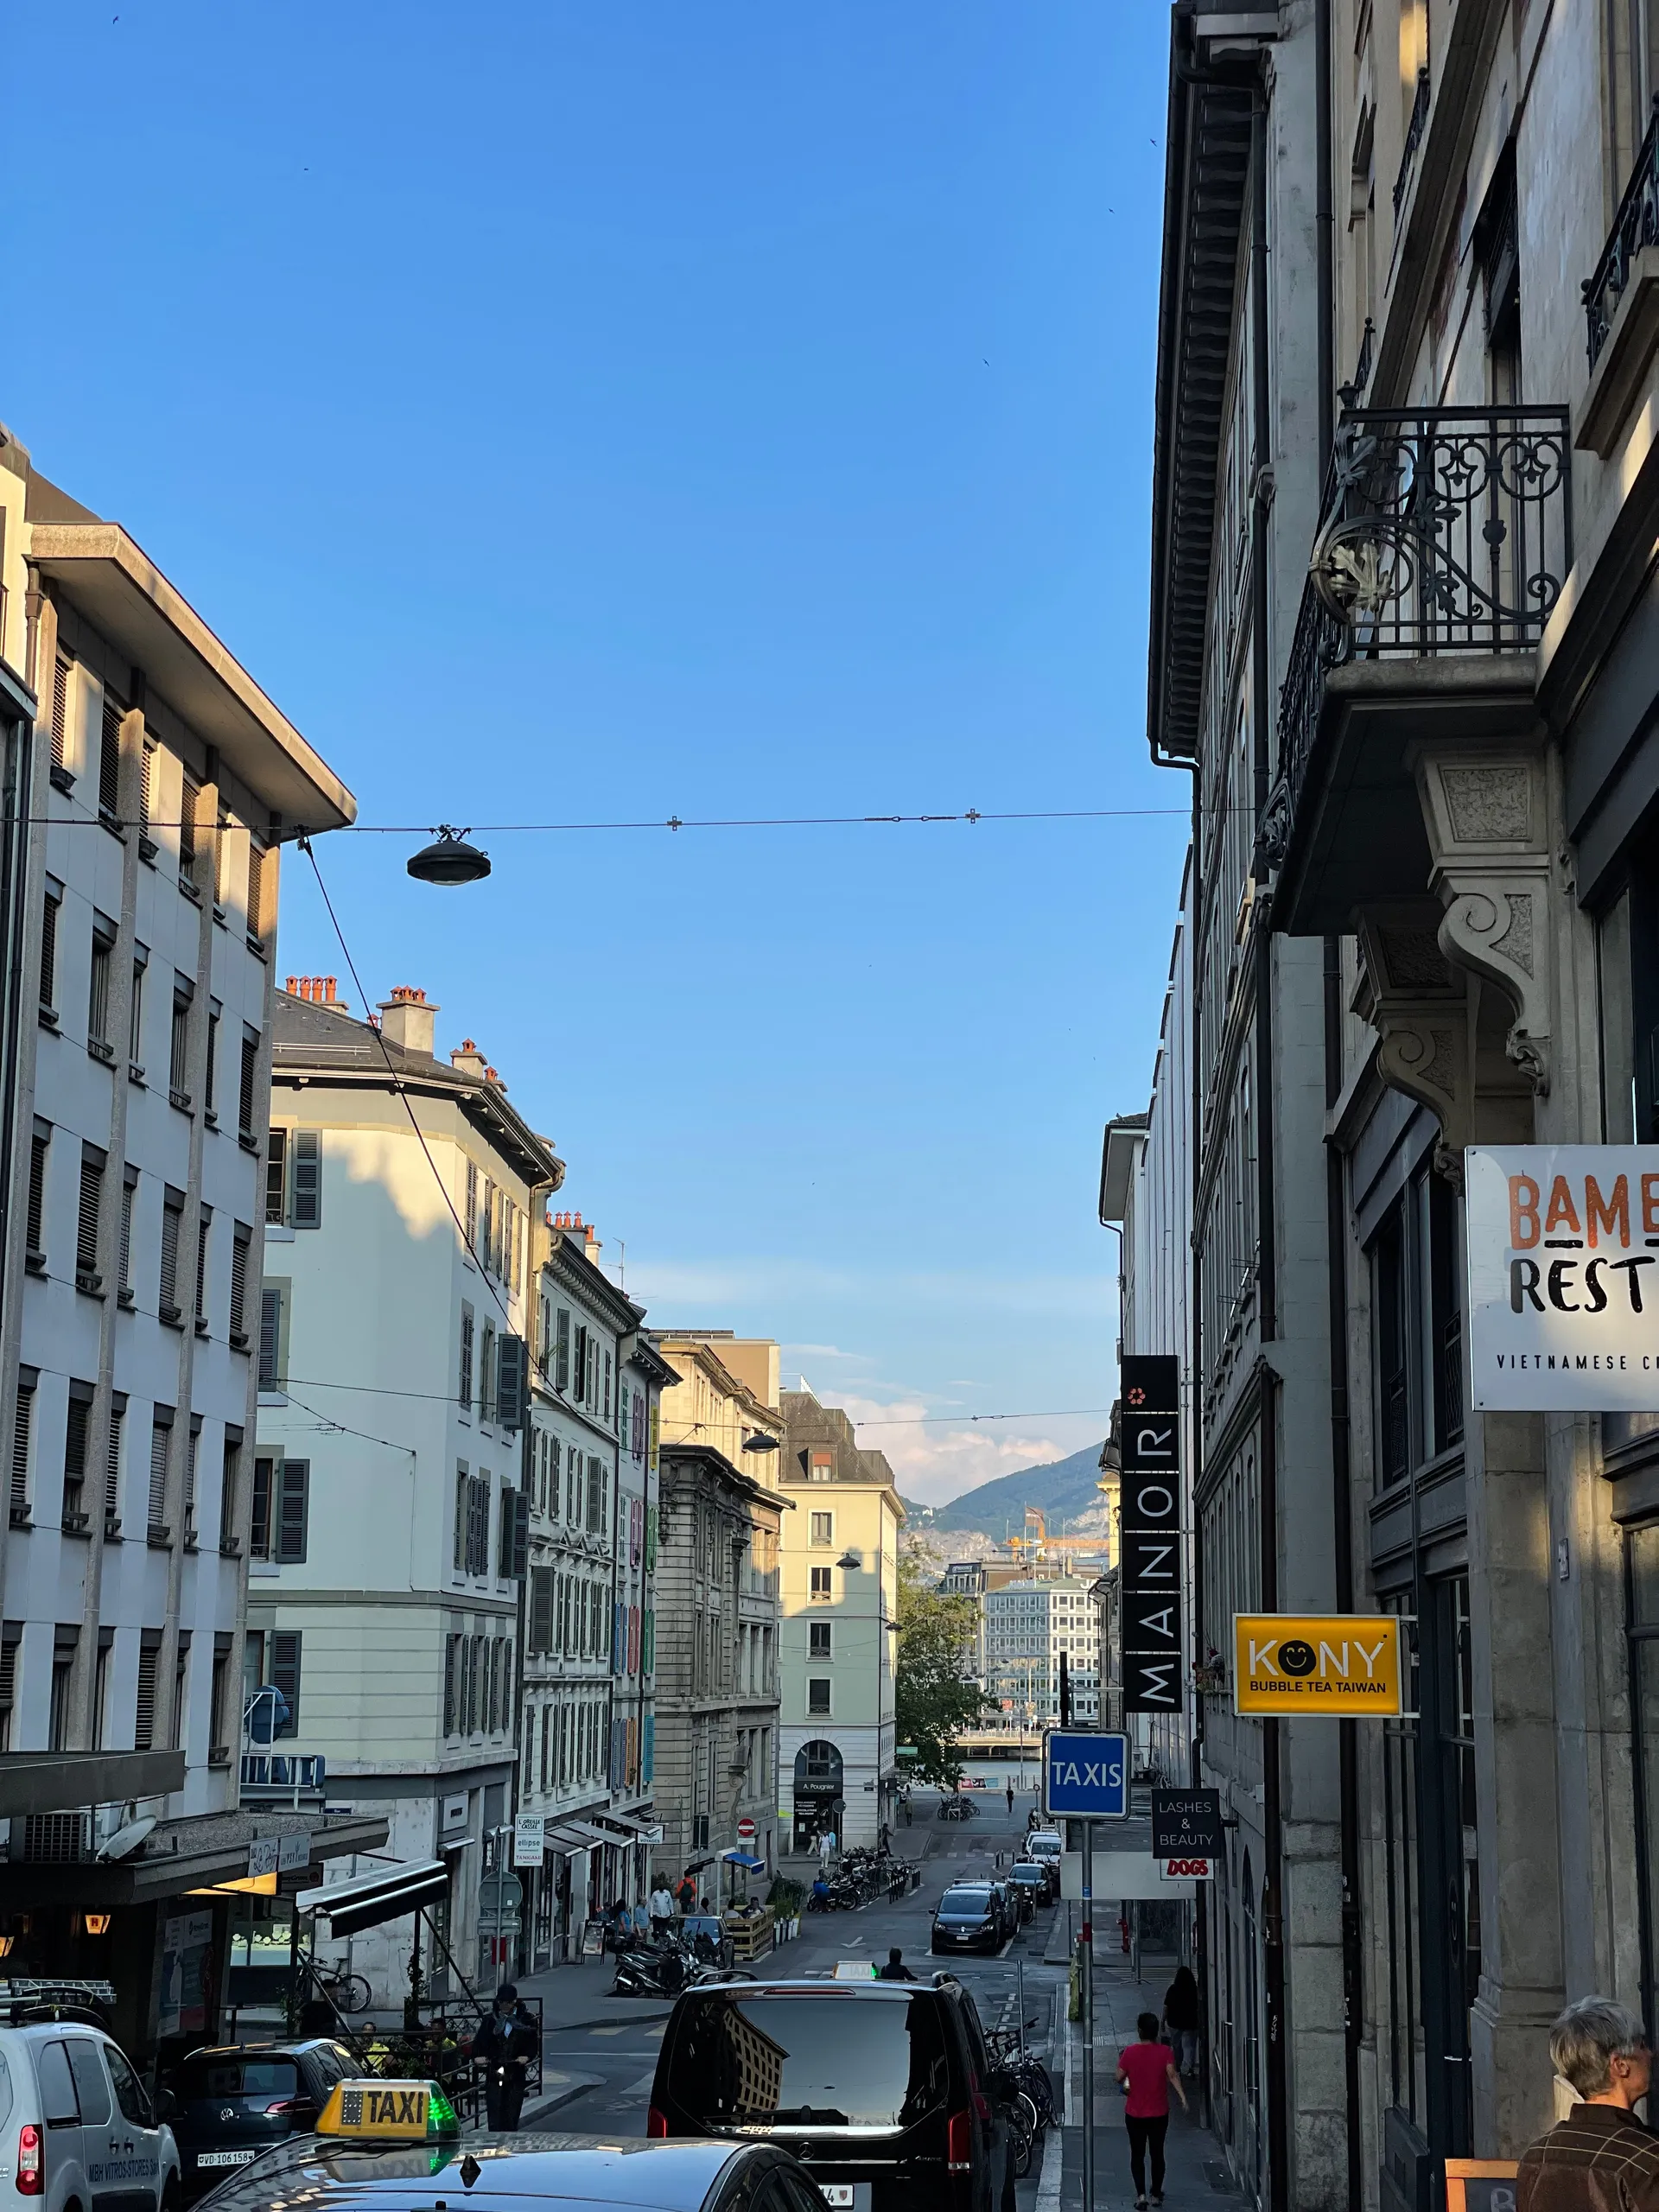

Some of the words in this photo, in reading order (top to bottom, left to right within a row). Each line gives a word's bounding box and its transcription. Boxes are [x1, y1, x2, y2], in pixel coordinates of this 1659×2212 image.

[1510, 1255, 1656, 1313] REST
[1497, 1354, 1627, 1370] VIETNAMESE
[1643, 1356, 1659, 1370] C
[1137, 1427, 1175, 1704] MANOR
[1249, 1681, 1303, 1693] BUBBLE
[1306, 1681, 1332, 1693] TEA
[1335, 1681, 1387, 1694] TAIWAN
[1051, 1761, 1122, 1788] TAXIS
[1159, 1802, 1211, 1813] LASHES
[1181, 1818, 1191, 1829] &
[518, 1840, 541, 1848] ellipse
[1160, 1834, 1214, 1846] BEAUTY
[1166, 1859, 1209, 1876] DOGS
[367, 2090, 424, 2124] TAXI
[89, 2164, 103, 2183] MBH
